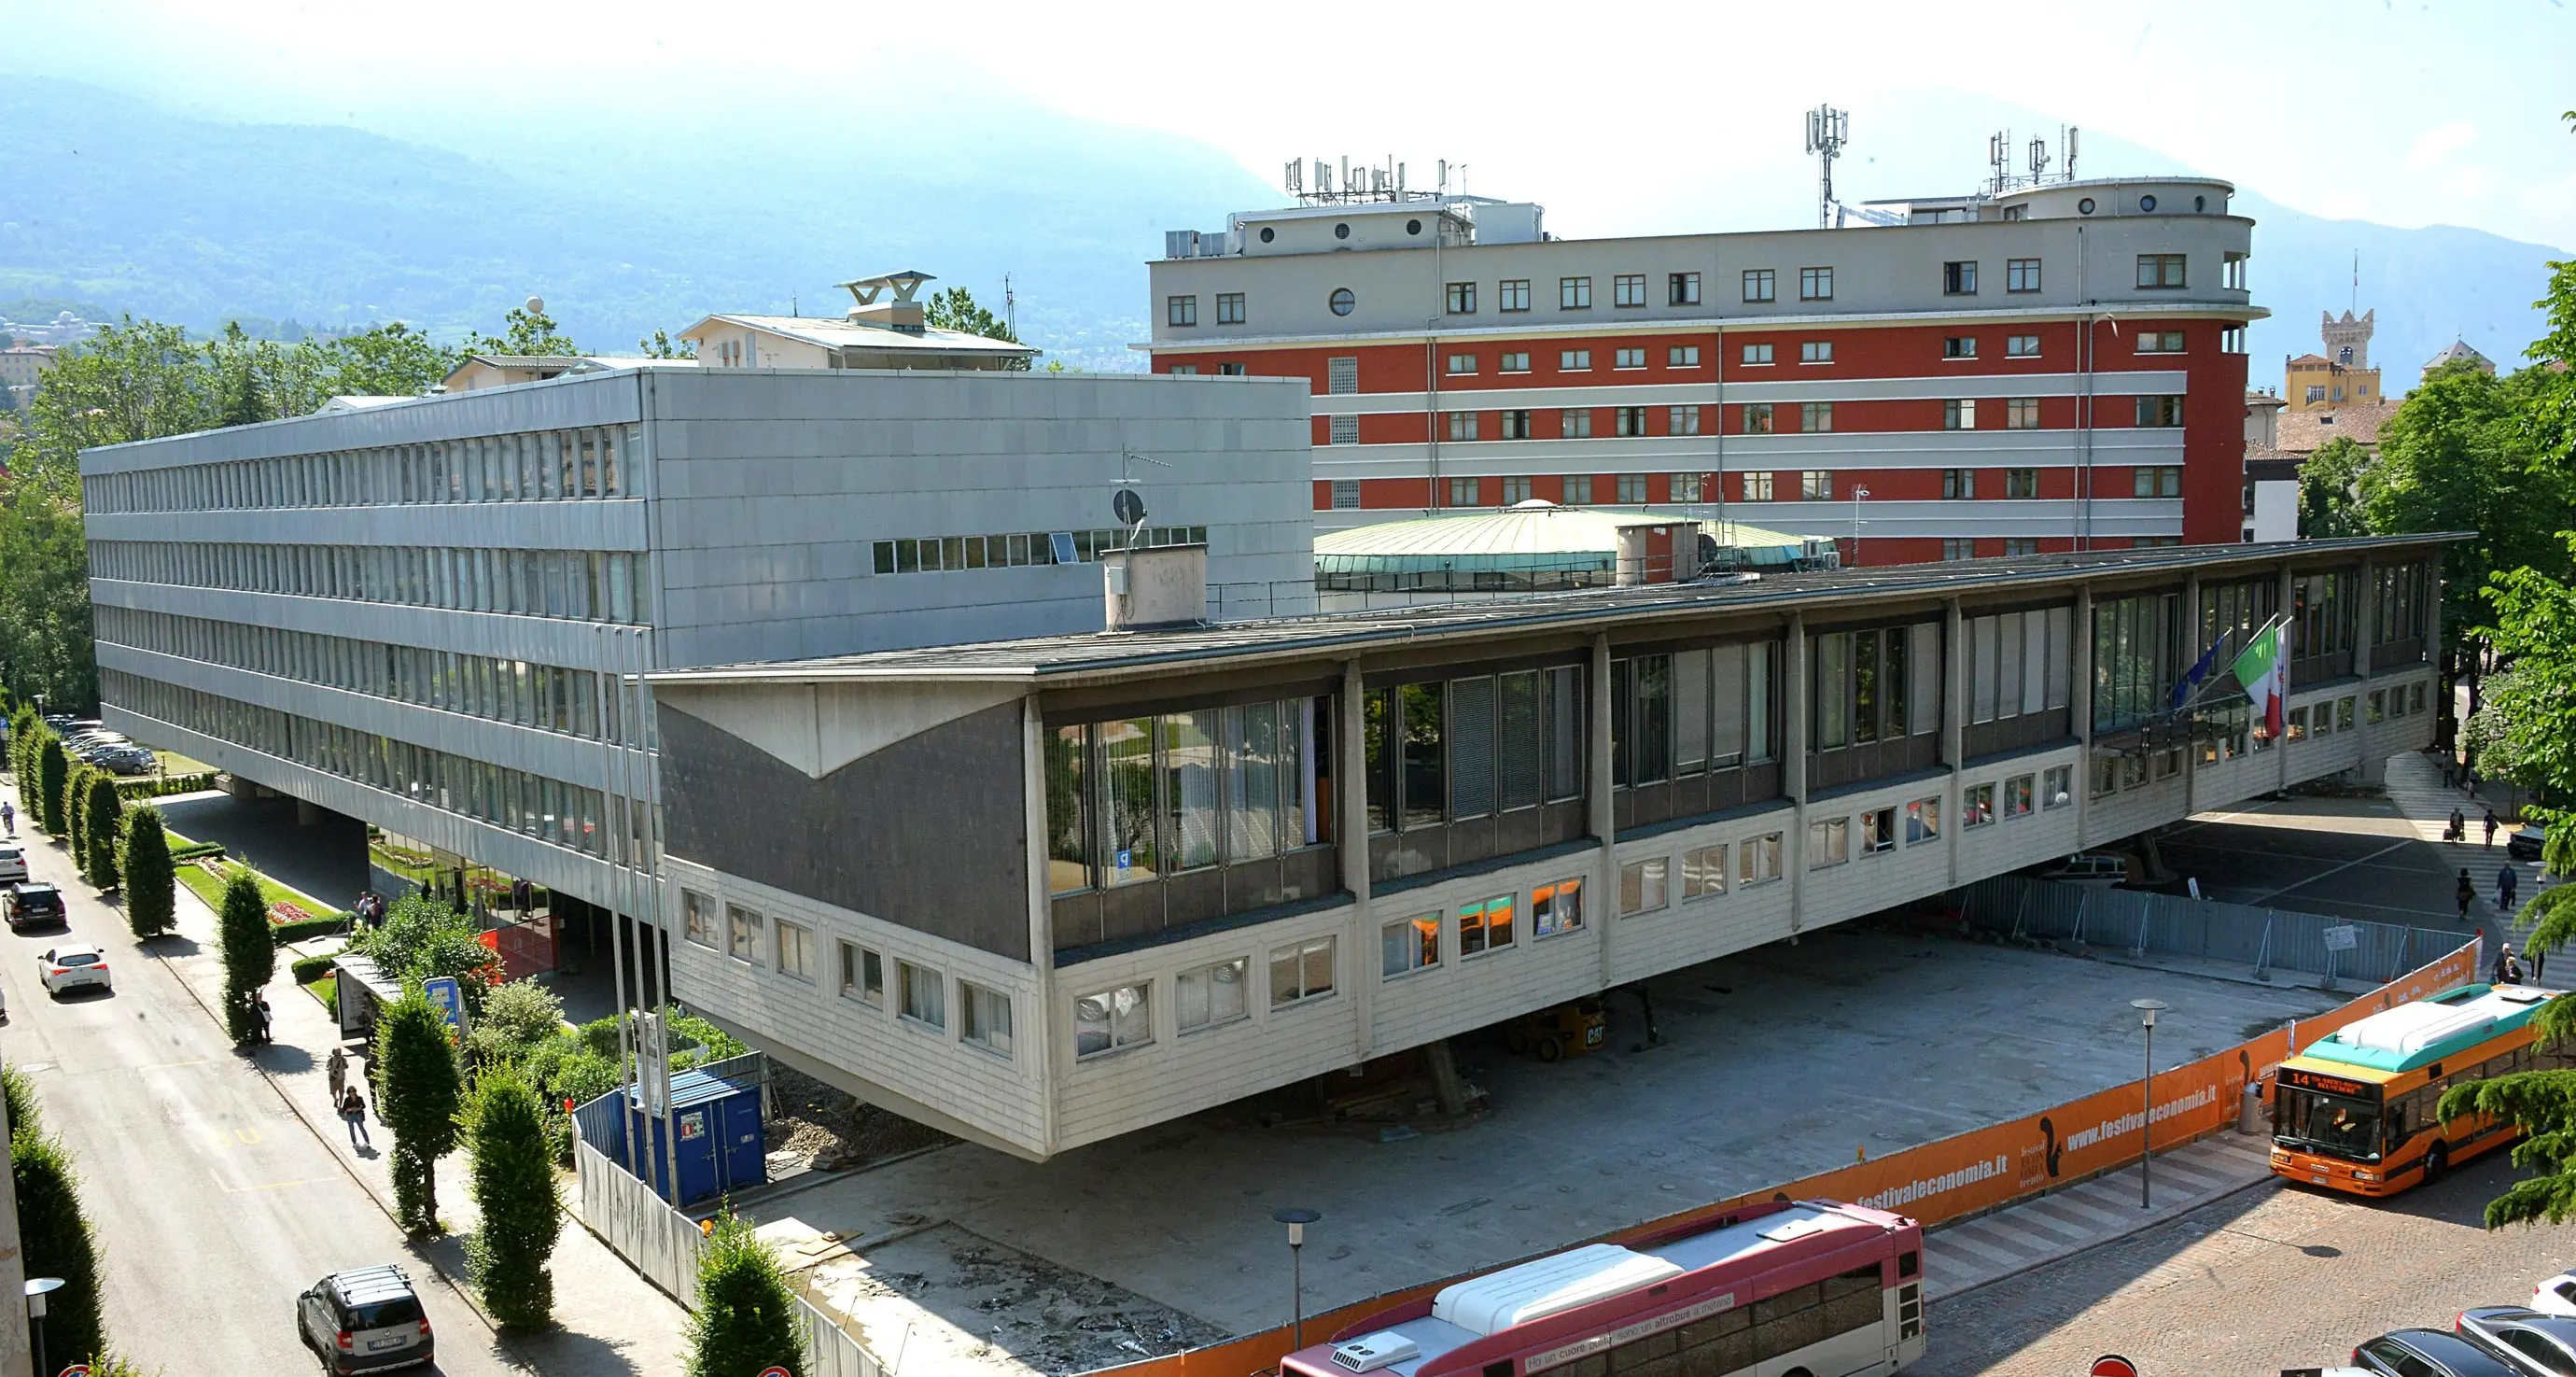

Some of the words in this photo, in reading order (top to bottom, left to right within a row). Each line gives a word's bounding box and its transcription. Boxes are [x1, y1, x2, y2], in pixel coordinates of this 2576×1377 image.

[1588, 1027, 1603, 1045] CAT
[2293, 1073, 2309, 1086] 14
[2066, 1084, 2218, 1152] www.festivaeconomia.it
[2021, 1139, 2045, 1157] festival
[2020, 1174, 2044, 1188] trento
[1528, 1357, 1542, 1370] Ho
[1545, 1353, 1556, 1364] un
[1559, 1343, 1586, 1358] cuore
[1617, 1328, 1638, 1341] sono
[1641, 1322, 1652, 1333] un
[1655, 1311, 1690, 1328] altrobus
[1701, 1297, 1732, 1314] metano
